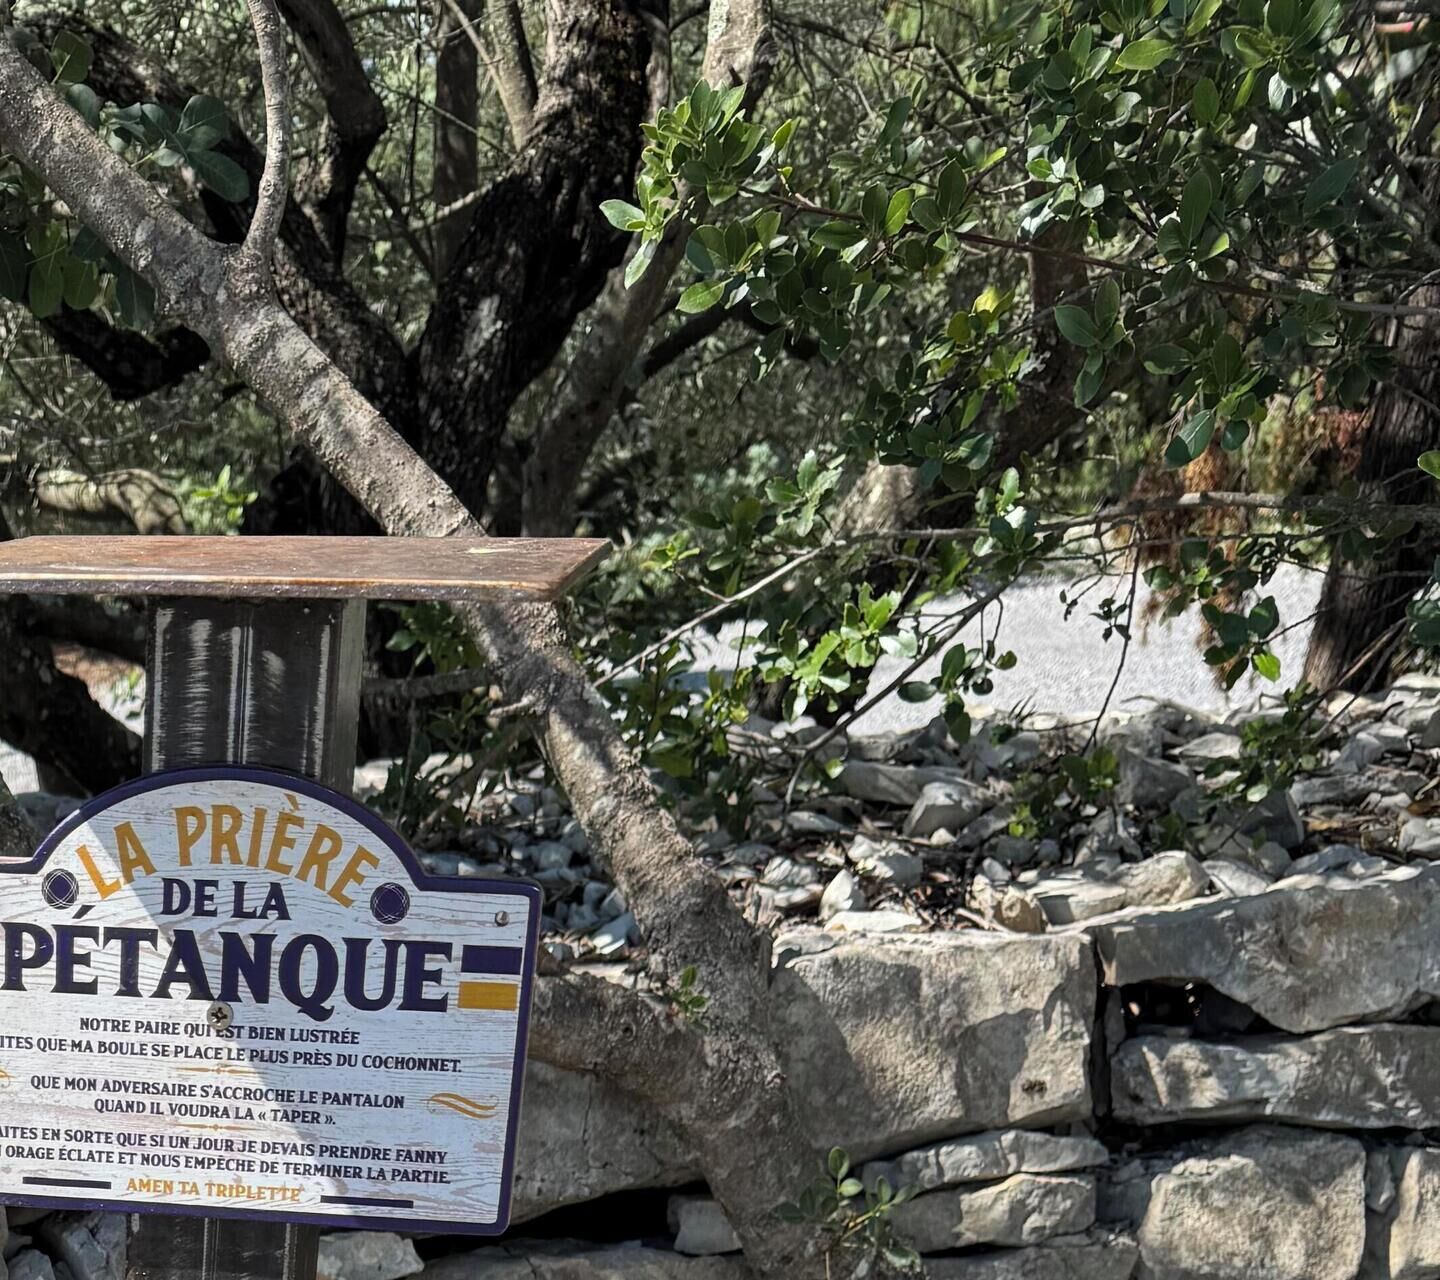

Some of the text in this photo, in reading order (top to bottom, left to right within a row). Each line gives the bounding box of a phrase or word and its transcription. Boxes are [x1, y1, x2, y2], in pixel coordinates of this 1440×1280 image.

[76, 793, 380, 908] LA PRIÈRE
[160, 878, 292, 920] DE LA
[0, 904, 452, 1021] PÉTANQUE
[80, 1017, 131, 1033] NOTRE
[134, 1020, 181, 1035] PAIRE
[183, 1023, 211, 1038] QUI
[248, 1026, 286, 1041] BIEN
[290, 1027, 360, 1044] LUSTRÉE
[37, 1037, 67, 1053] QUE
[70, 1039, 93, 1053] MA
[97, 1041, 148, 1056] BOULE
[151, 1044, 170, 1058] SE
[174, 1045, 223, 1060] PLACE
[227, 1047, 246, 1062] LE
[249, 1049, 289, 1064] PLUS
[293, 1049, 332, 1066] PRÈS
[336, 1054, 358, 1067] DU
[362, 1055, 462, 1072] COCHONNET.
[30, 1075, 61, 1091] QUE
[64, 1077, 97, 1091] MON
[100, 1078, 197, 1097] ADVERSAIRE
[299, 1090, 318, 1105] LE
[322, 1091, 405, 1109] PANTALON
[94, 1098, 146, 1114] QUAND
[149, 1101, 164, 1115] IL
[168, 1103, 231, 1119] VOUDRA
[234, 1106, 255, 1120] LA
[270, 1109, 321, 1124] TAPER
[41, 1128, 61, 1141] EN
[64, 1129, 113, 1144] SORTE
[116, 1132, 147, 1148] QUE
[150, 1134, 165, 1148] SI
[169, 1135, 190, 1149] UN
[193, 1137, 237, 1152] JOUR
[237, 1140, 257, 1154] JE
[261, 1141, 315, 1157] DEVAIS
[318, 1144, 391, 1161] PRENDRE
[395, 1149, 448, 1164] FANNY
[5, 1145, 55, 1160] ORAGE
[59, 1145, 114, 1163] ÉCLATE
[118, 1151, 138, 1165] ET
[141, 1153, 181, 1168] NOUS
[184, 1155, 256, 1173] EMPÊCHE
[259, 1160, 279, 1174] DE
[282, 1161, 363, 1179] TERMINER
[367, 1167, 387, 1181] LA
[391, 1168, 451, 1184] PARTIE.
[126, 1178, 302, 1202] AMEN TA TRIPLETTE
